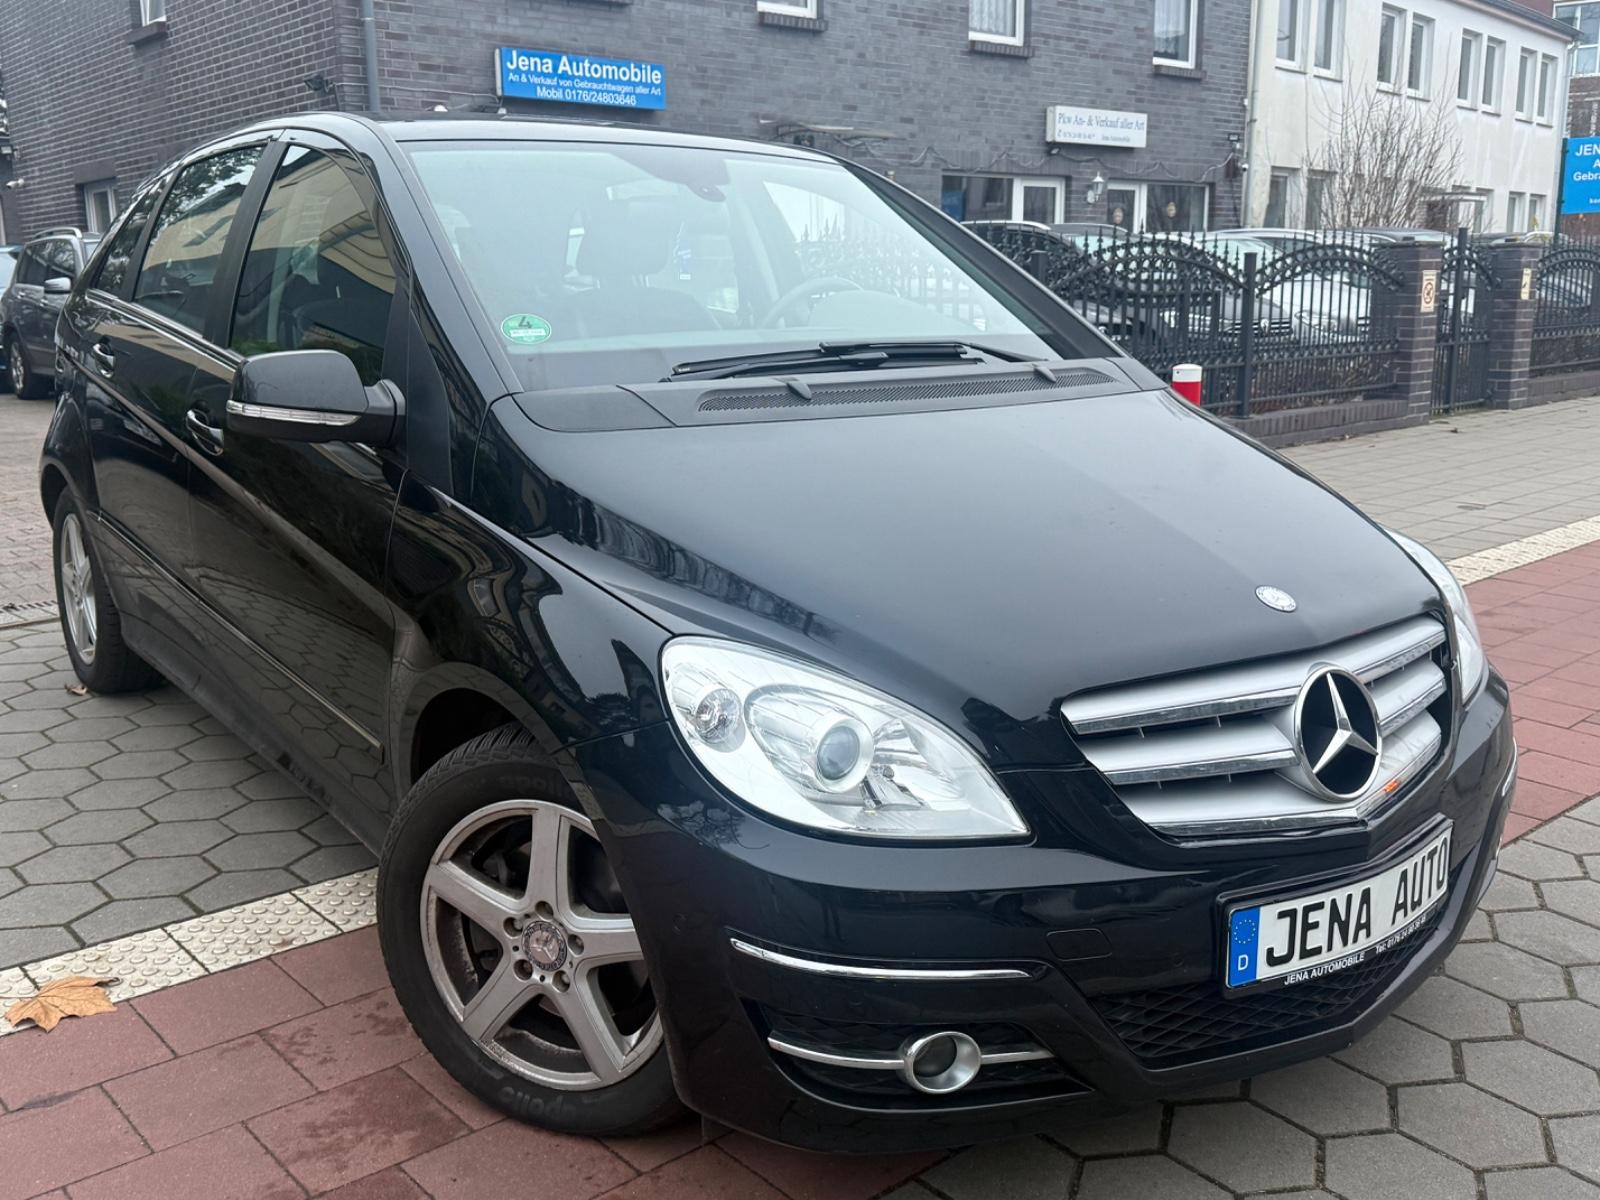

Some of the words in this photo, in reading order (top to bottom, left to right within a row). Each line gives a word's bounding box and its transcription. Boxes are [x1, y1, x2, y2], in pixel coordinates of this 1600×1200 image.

[507, 50, 552, 73] Jena
[558, 56, 661, 84] Automobile
[508, 72, 520, 82] An
[520, 73, 528, 83] &
[528, 74, 558, 86] Verkauf
[559, 79, 573, 88] von
[573, 78, 634, 94] Gebrauchtwagen
[650, 87, 662, 96] Art
[536, 86, 564, 99] Mobil
[518, 316, 533, 328] 4
[1265, 886, 1371, 968] JENA
[1391, 837, 1448, 926] AUTO
[1237, 954, 1249, 971] D
[1284, 970, 1309, 985] JENA
[1310, 951, 1365, 979] AUTOMOBILE
